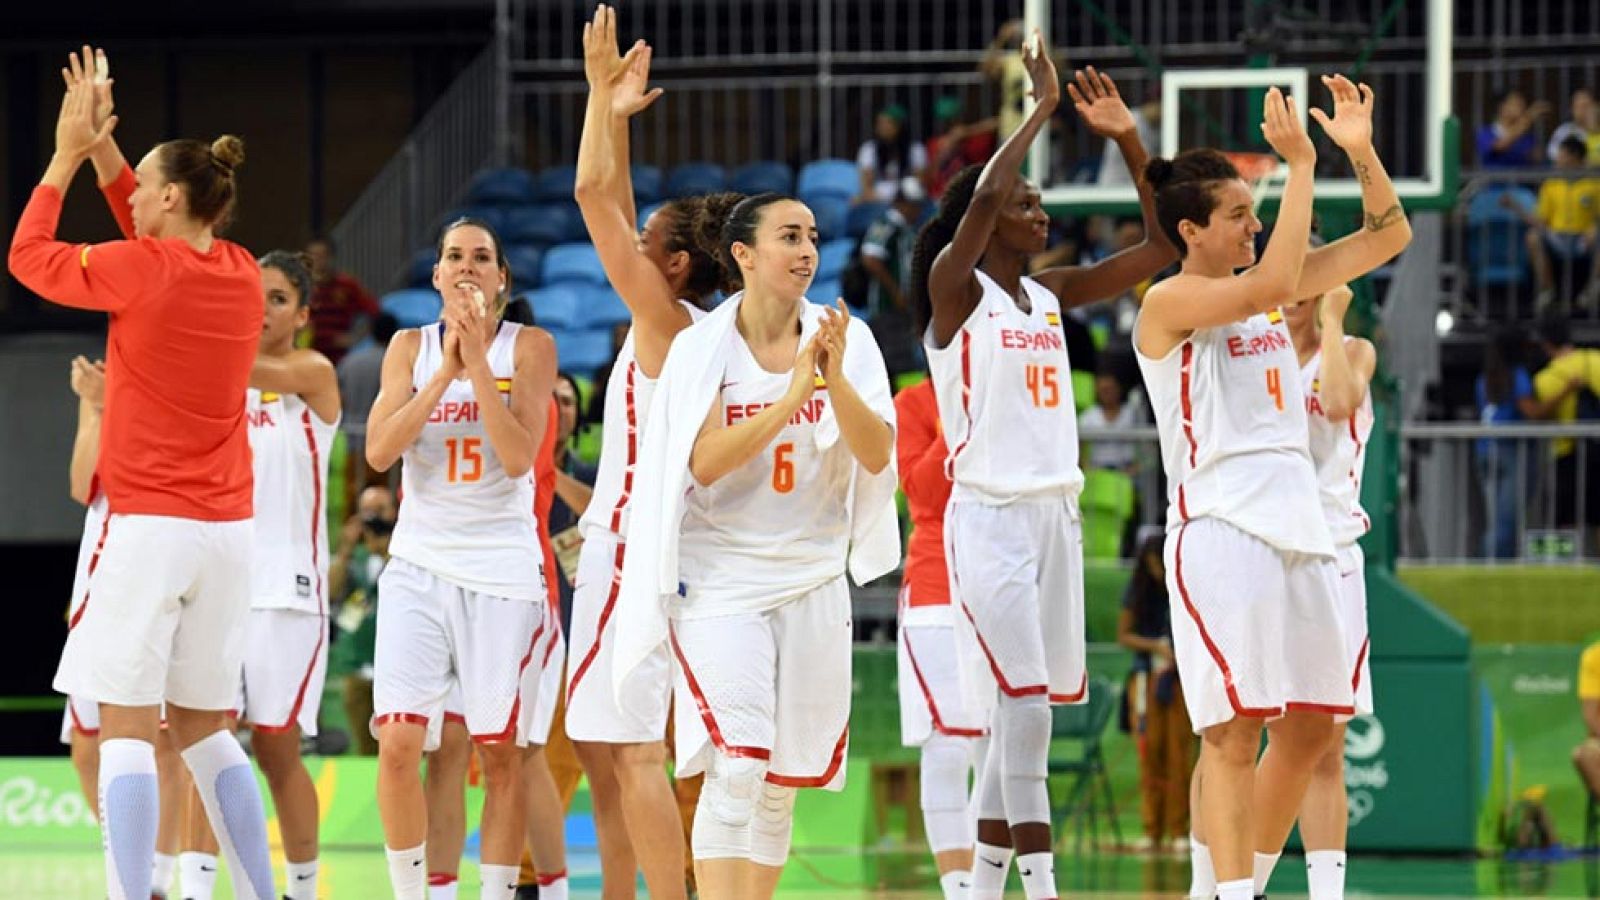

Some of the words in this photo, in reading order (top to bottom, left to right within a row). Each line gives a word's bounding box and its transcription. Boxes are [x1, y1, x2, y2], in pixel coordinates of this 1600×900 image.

[1025, 363, 1060, 408] 45
[1265, 368, 1285, 412] 4
[445, 437, 482, 483] 15
[772, 442, 795, 494] 6
[0, 776, 97, 827] Rio
